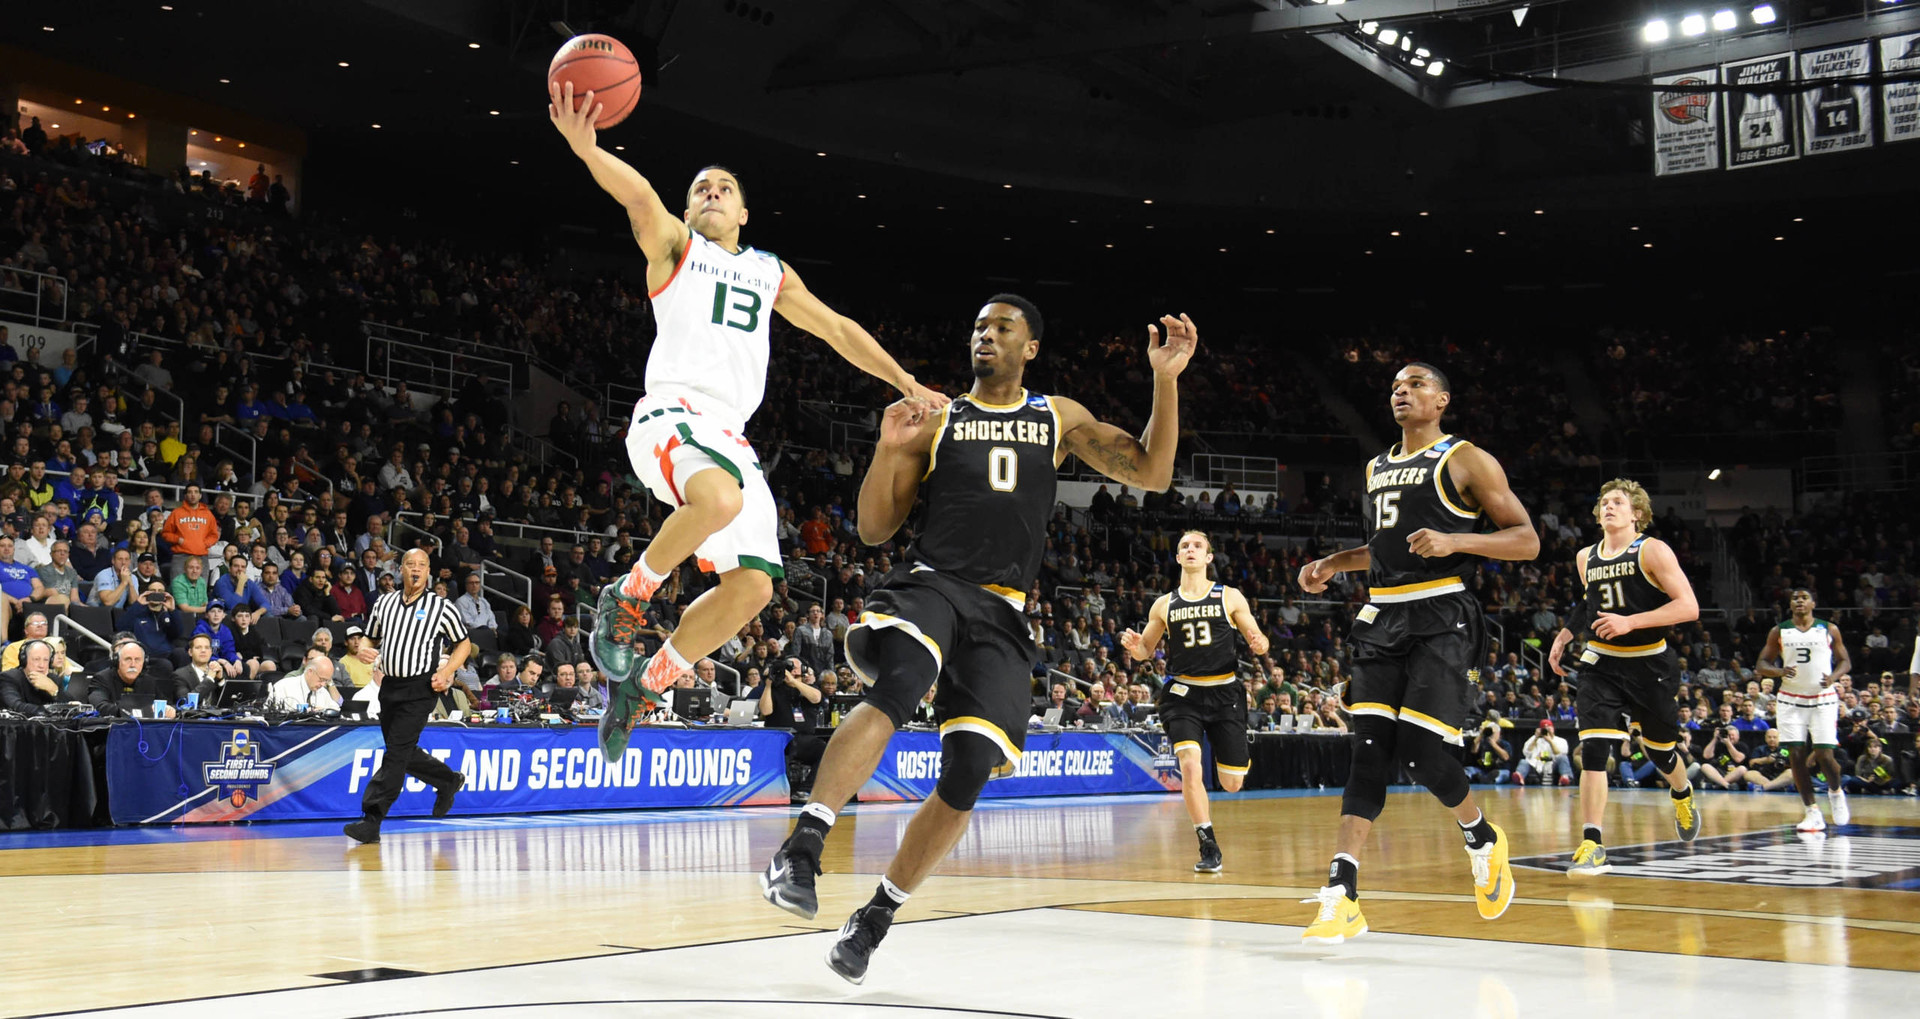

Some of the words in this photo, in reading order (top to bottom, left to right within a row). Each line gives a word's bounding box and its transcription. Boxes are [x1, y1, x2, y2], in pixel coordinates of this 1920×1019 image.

[1816, 48, 1854, 64] LENNY
[1739, 61, 1778, 77] JIMMY
[1811, 58, 1862, 75] WILKENS
[1737, 71, 1781, 86] WALKER
[1826, 110, 1848, 128] 14
[1749, 121, 1772, 139] 24
[1810, 134, 1867, 151] 1957-1960
[1736, 144, 1790, 162] 1964-1967
[206, 207, 224, 220] 213
[711, 281, 762, 333] 13
[19, 333, 46, 350] 109
[953, 420, 1049, 446] SHOCKERS
[988, 446, 1018, 493] 0
[1368, 467, 1428, 494] SHOCKERS
[1374, 490, 1402, 531] 15
[179, 516, 207, 525] MIAMI
[1587, 561, 1636, 583] SHOCKERS
[1598, 580, 1626, 610] 31
[1170, 604, 1221, 622] SHOCKERS
[1181, 620, 1212, 648] 33
[1796, 647, 1811, 664] 3
[225, 759, 247, 769] FIRST
[458, 748, 521, 792] AND
[528, 748, 643, 790] SECOND
[649, 748, 752, 787] ROUNDS
[897, 750, 942, 779] HOSTE
[1065, 750, 1114, 776] COLLEGE
[209, 769, 239, 780] SECOND
[239, 769, 269, 780] ROUNDS
